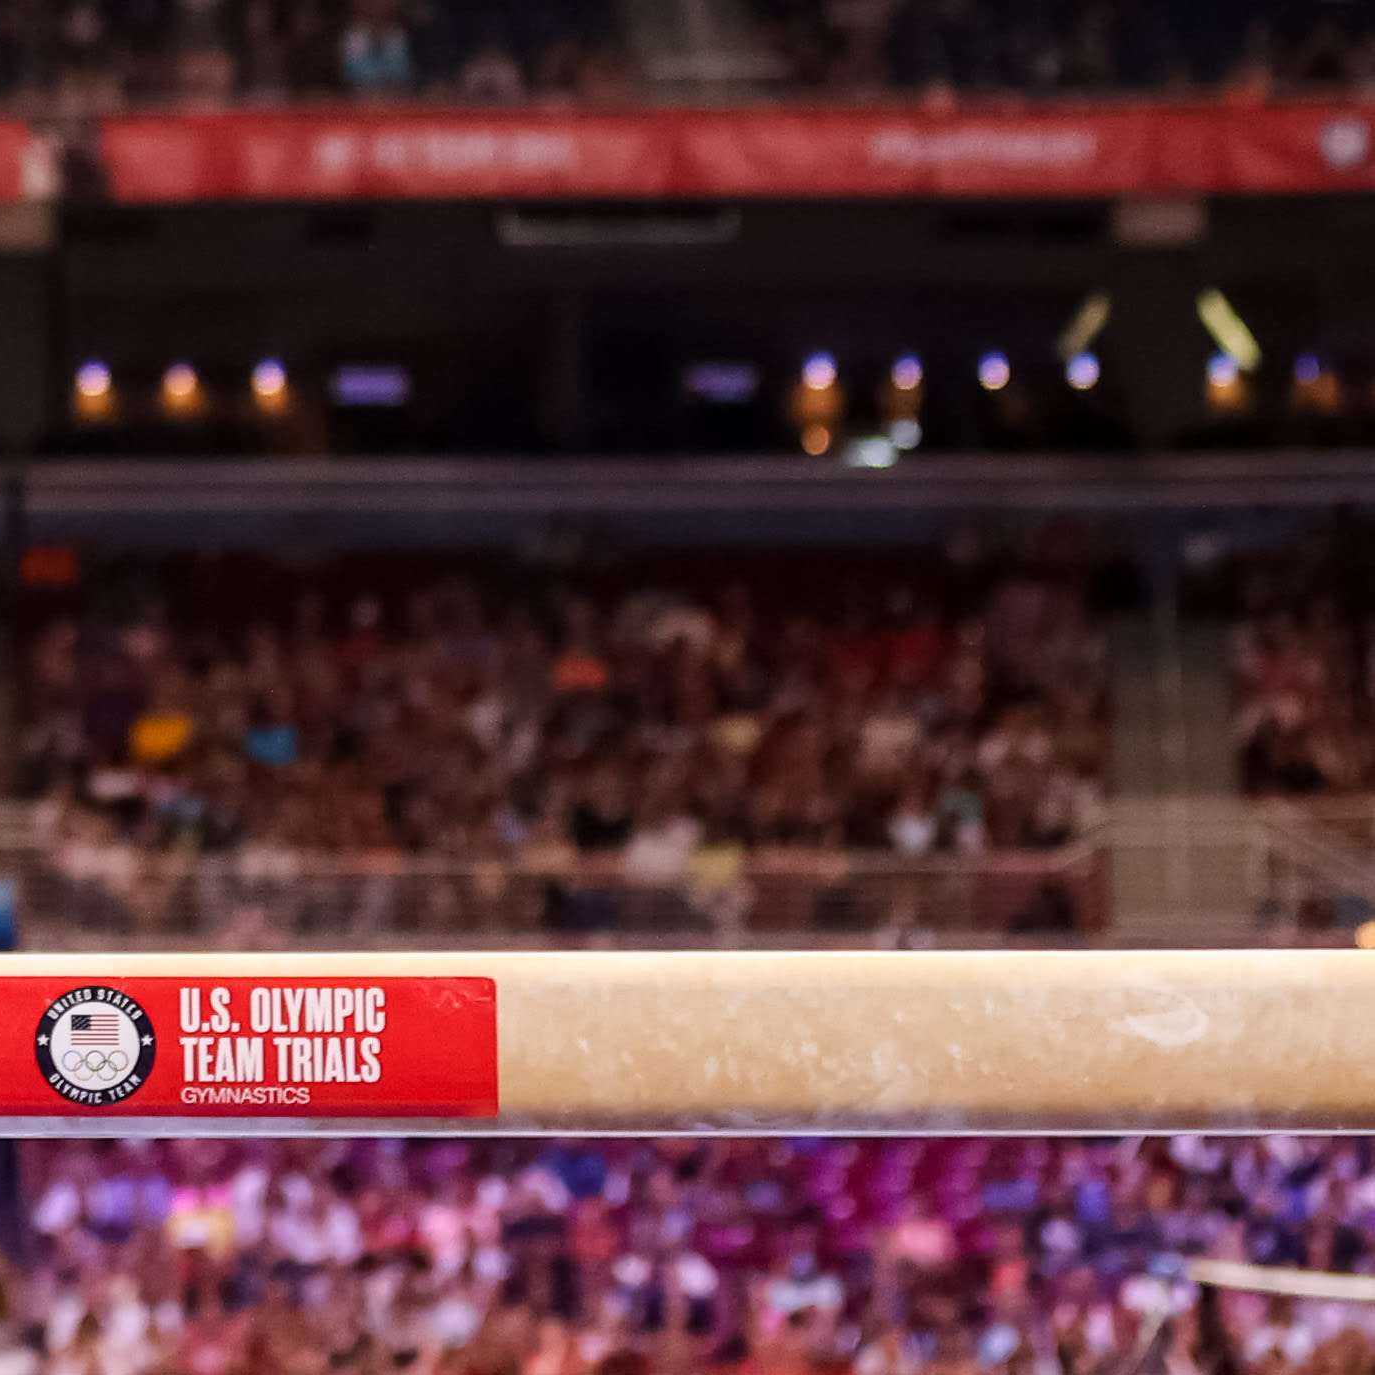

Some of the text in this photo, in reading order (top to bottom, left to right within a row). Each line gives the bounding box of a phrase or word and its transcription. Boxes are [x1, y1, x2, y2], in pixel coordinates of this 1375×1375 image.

[46, 988, 144, 1020] UNITED STATES
[179, 987, 386, 1033] U.S. OLYMPIC
[179, 1037, 382, 1083] TEAM TRIALS
[48, 1073, 142, 1104] OLYMPIC TEAM
[180, 1086, 311, 1104] GYMNASTICS
